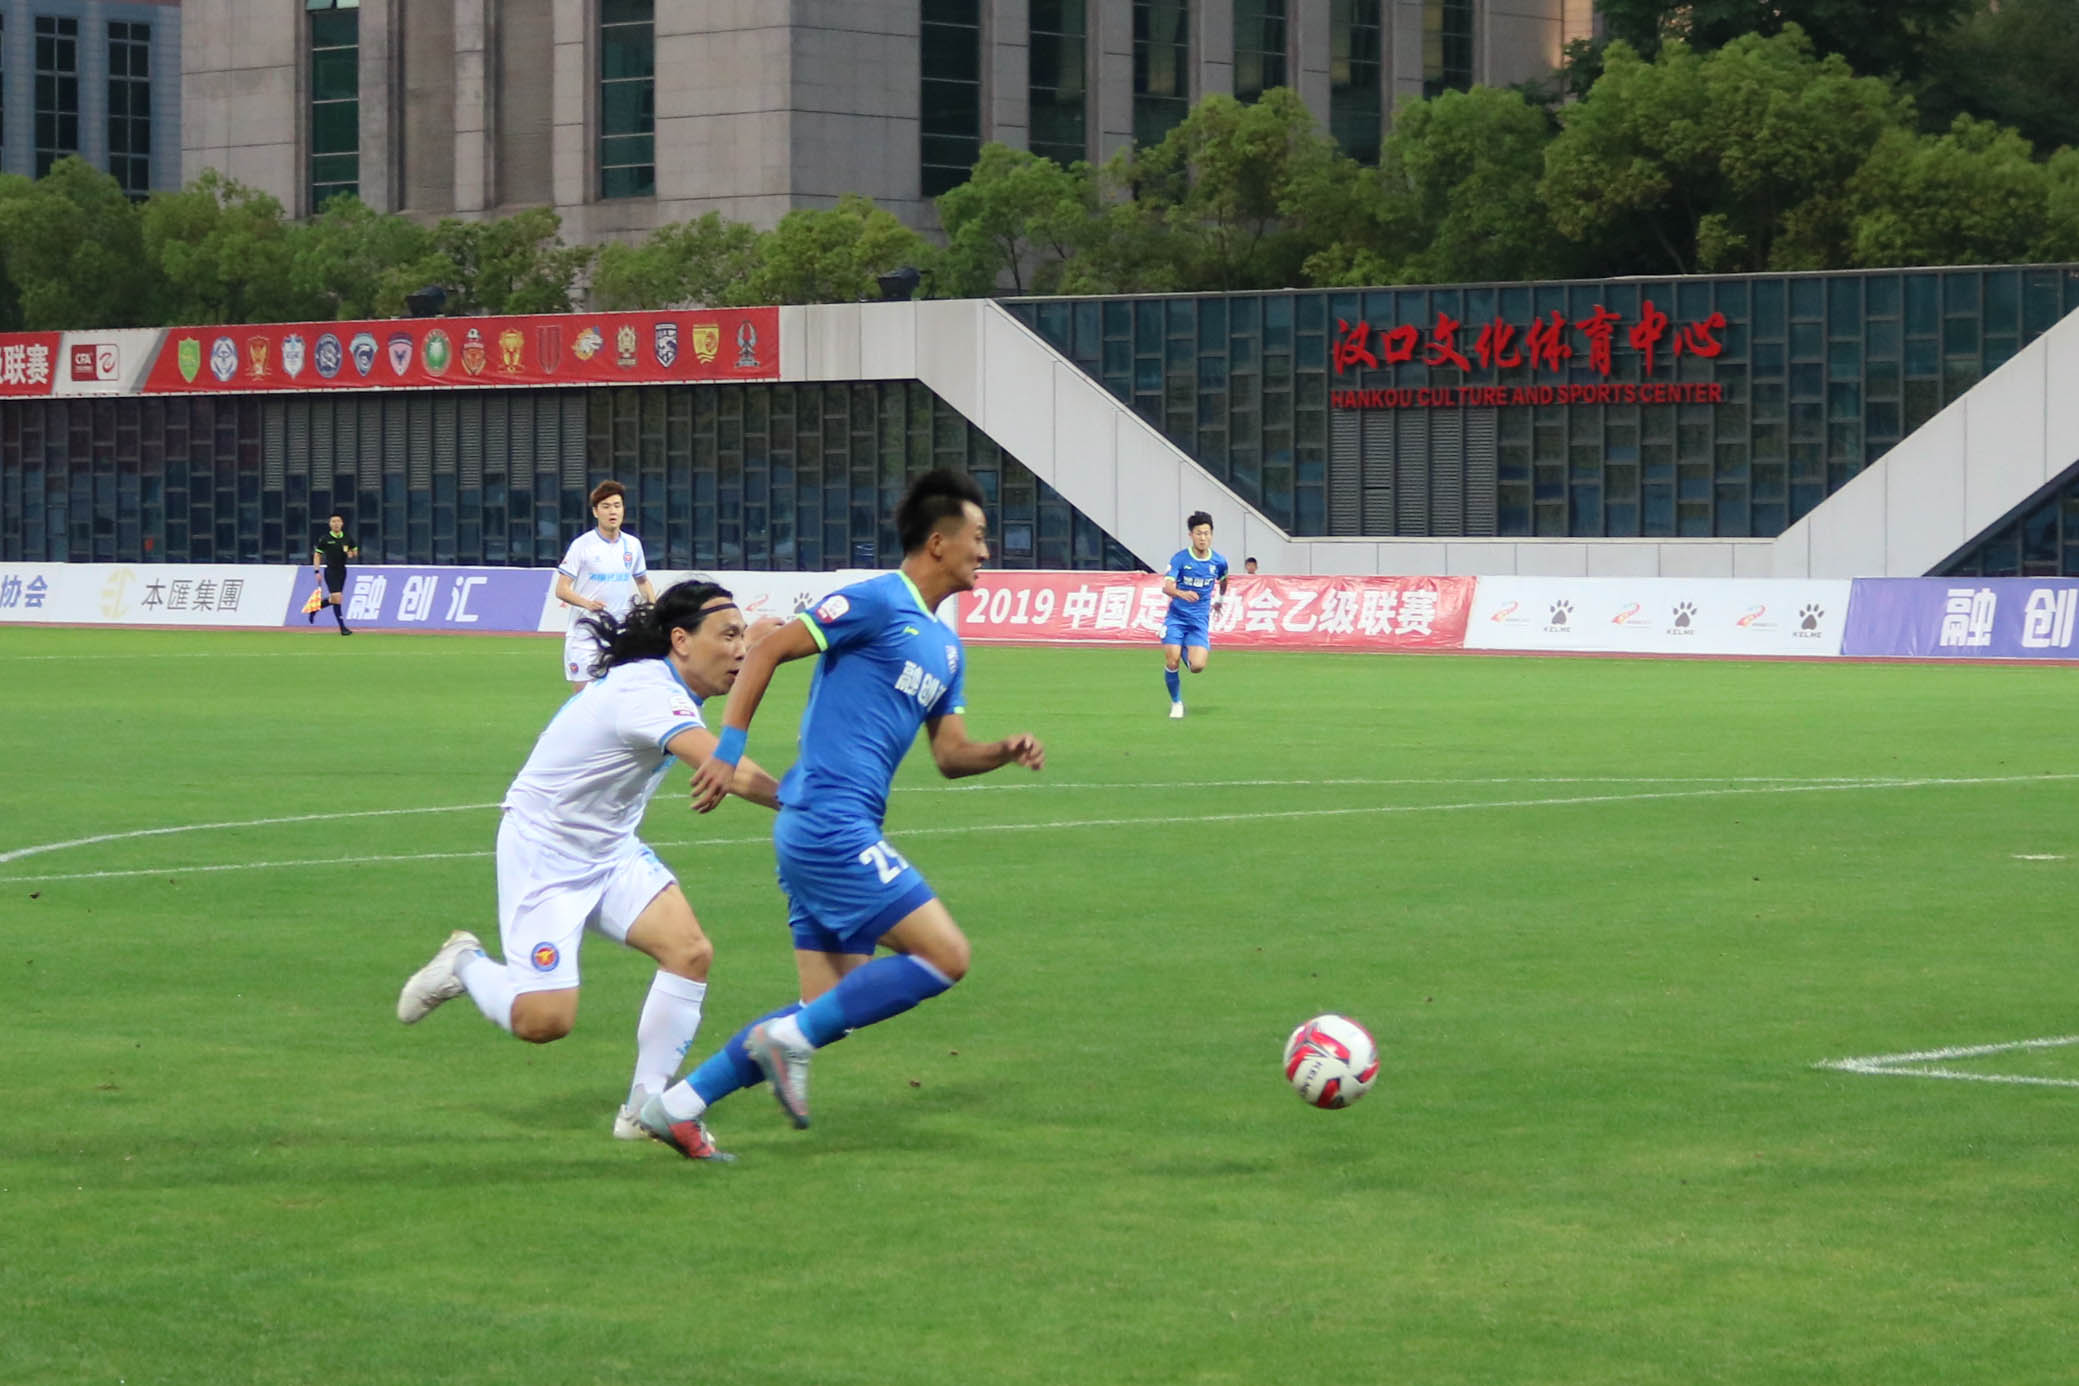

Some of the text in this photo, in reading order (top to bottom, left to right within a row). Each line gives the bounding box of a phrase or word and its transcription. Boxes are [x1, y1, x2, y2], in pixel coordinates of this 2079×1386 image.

[1332, 299, 1727, 376] 汉口文化体育中心
[1331, 382, 1723, 408] HANKOU CULTURE AND SPORTS CENTER
[0, 574, 48, 608] 协会
[141, 578, 244, 611] 本匯集團
[346, 575, 488, 622] 融创汇
[966, 584, 1438, 636] 2019 中国足协会乙级联赛
[1939, 588, 2078, 648] 融创
